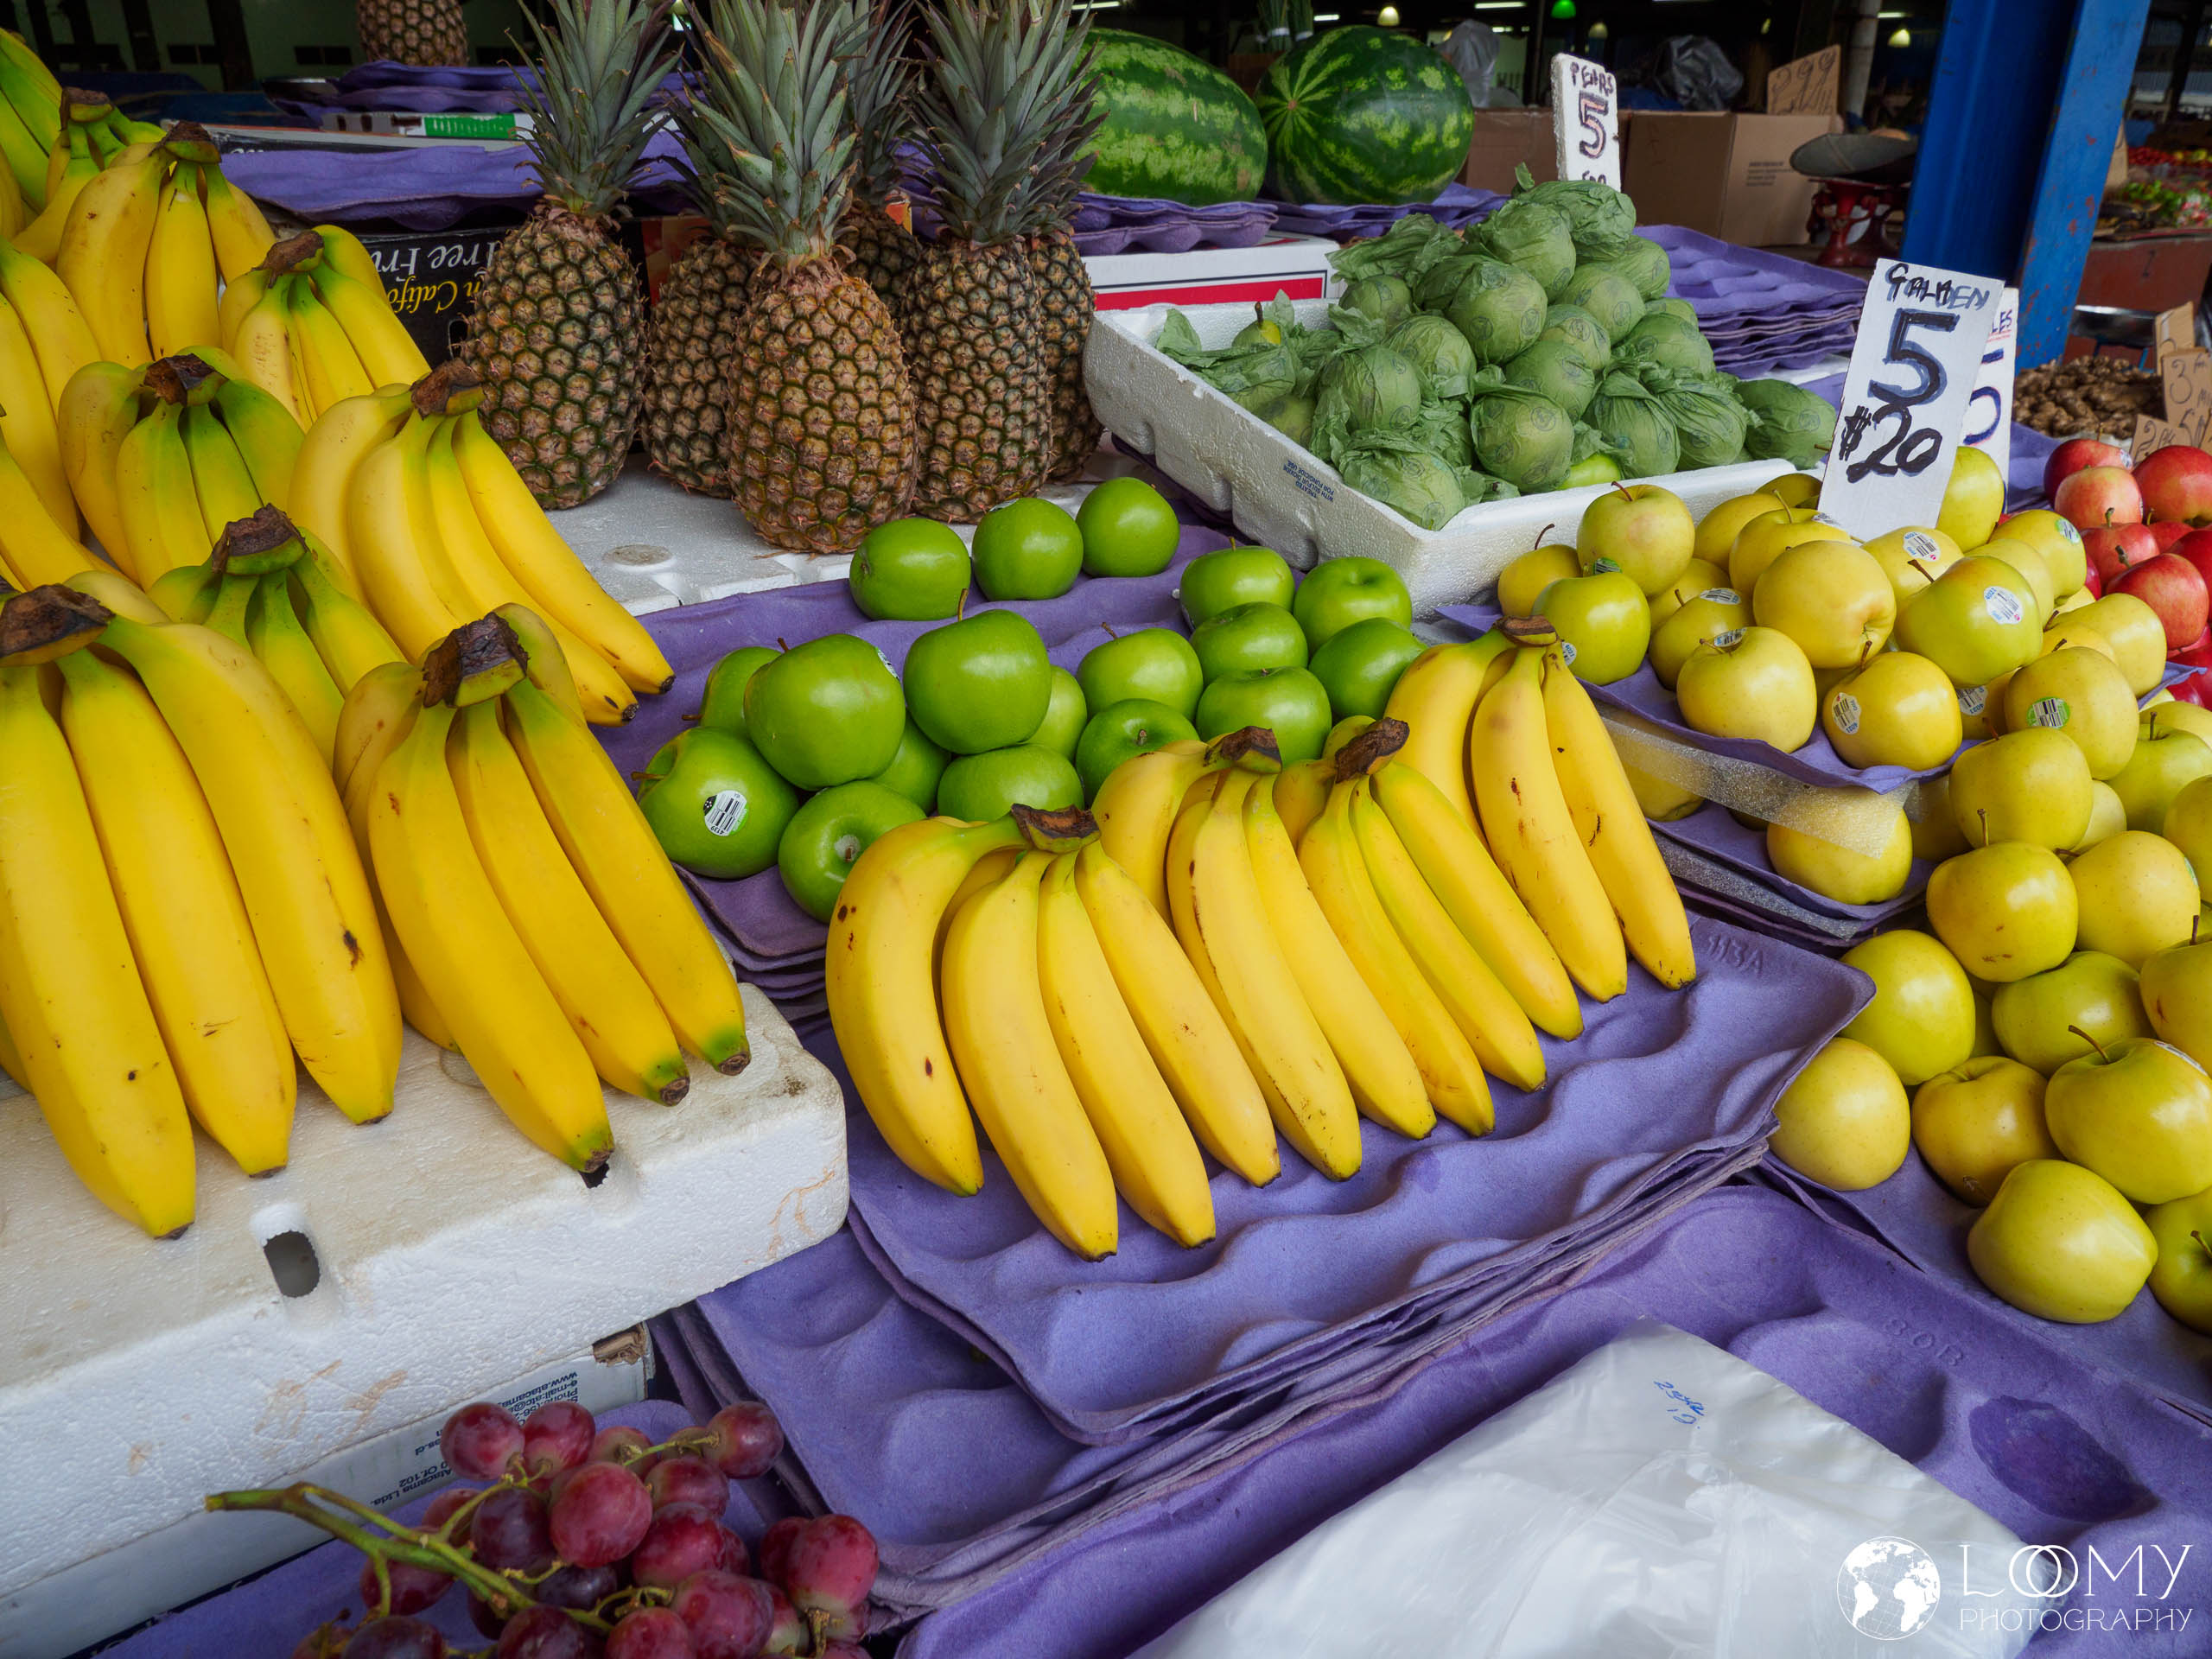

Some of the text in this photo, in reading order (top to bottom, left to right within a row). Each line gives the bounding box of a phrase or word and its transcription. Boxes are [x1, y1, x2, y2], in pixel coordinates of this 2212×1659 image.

[1570, 61, 1614, 97] PEARS
[1579, 90, 1609, 159] 5
[370, 247, 421, 282] Fru
[1867, 308, 1961, 408] 5
